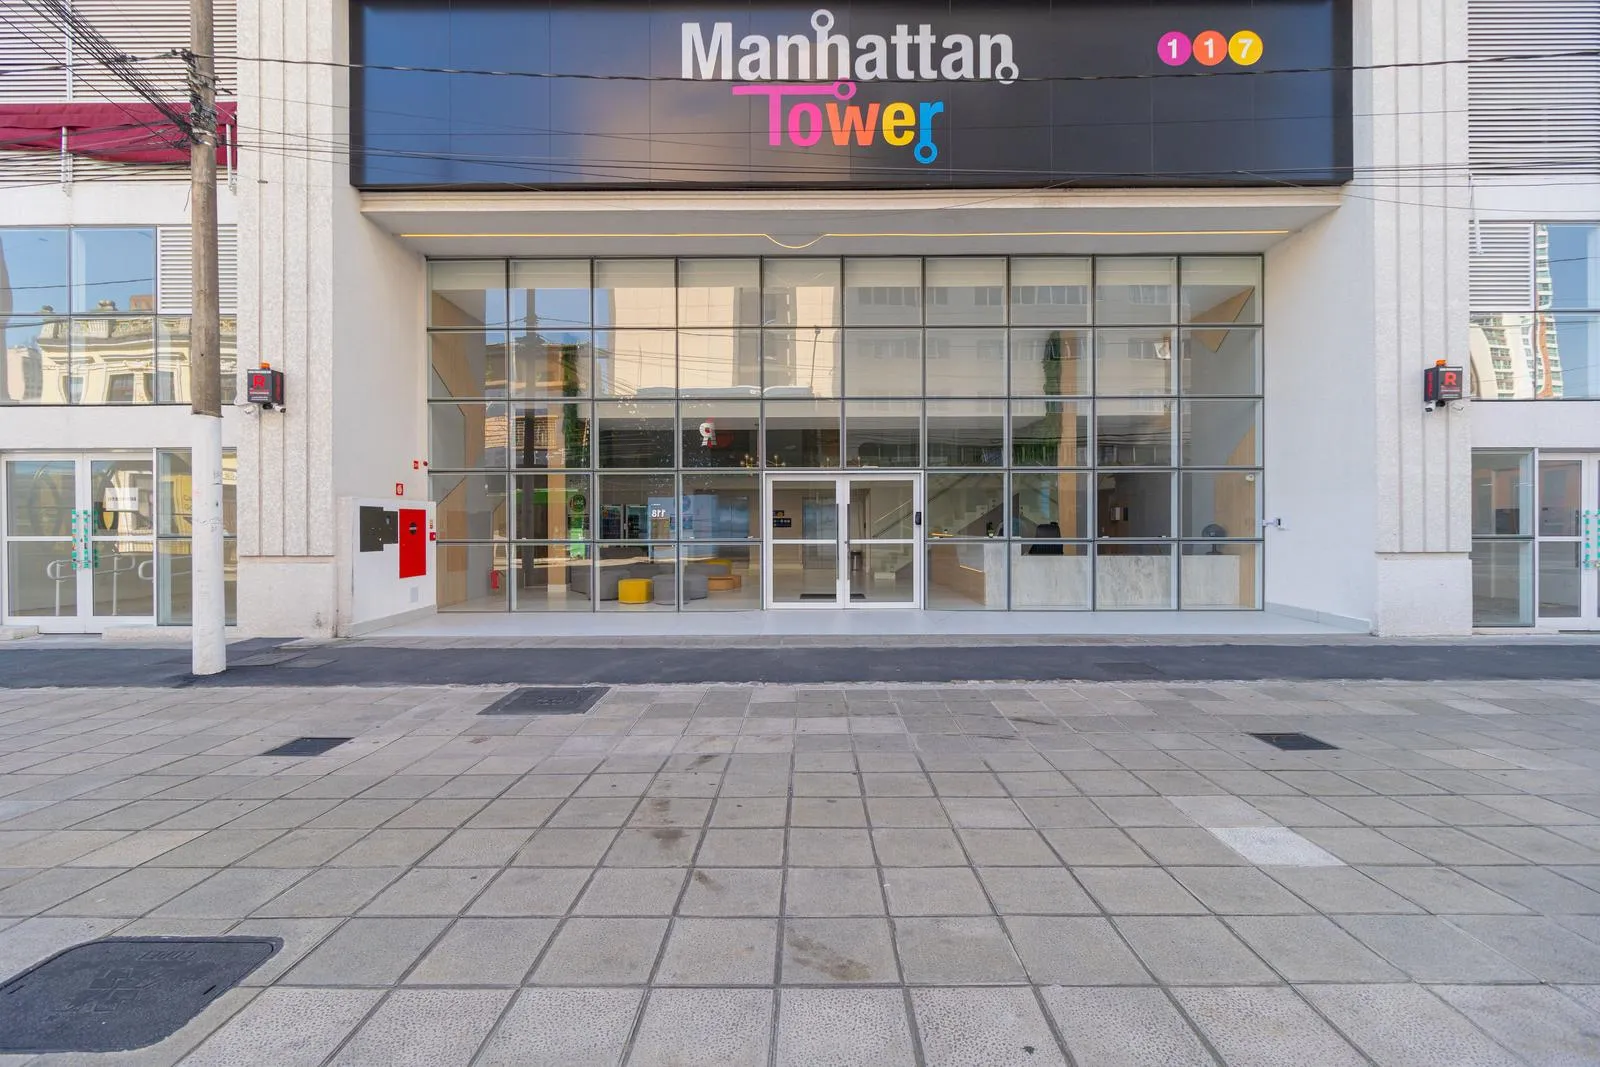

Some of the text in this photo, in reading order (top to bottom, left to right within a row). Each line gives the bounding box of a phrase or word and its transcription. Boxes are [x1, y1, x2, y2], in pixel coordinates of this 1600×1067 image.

[680, 9, 1019, 84] Manhattan
[1167, 38, 1253, 59] 117
[732, 77, 944, 164] Tower
